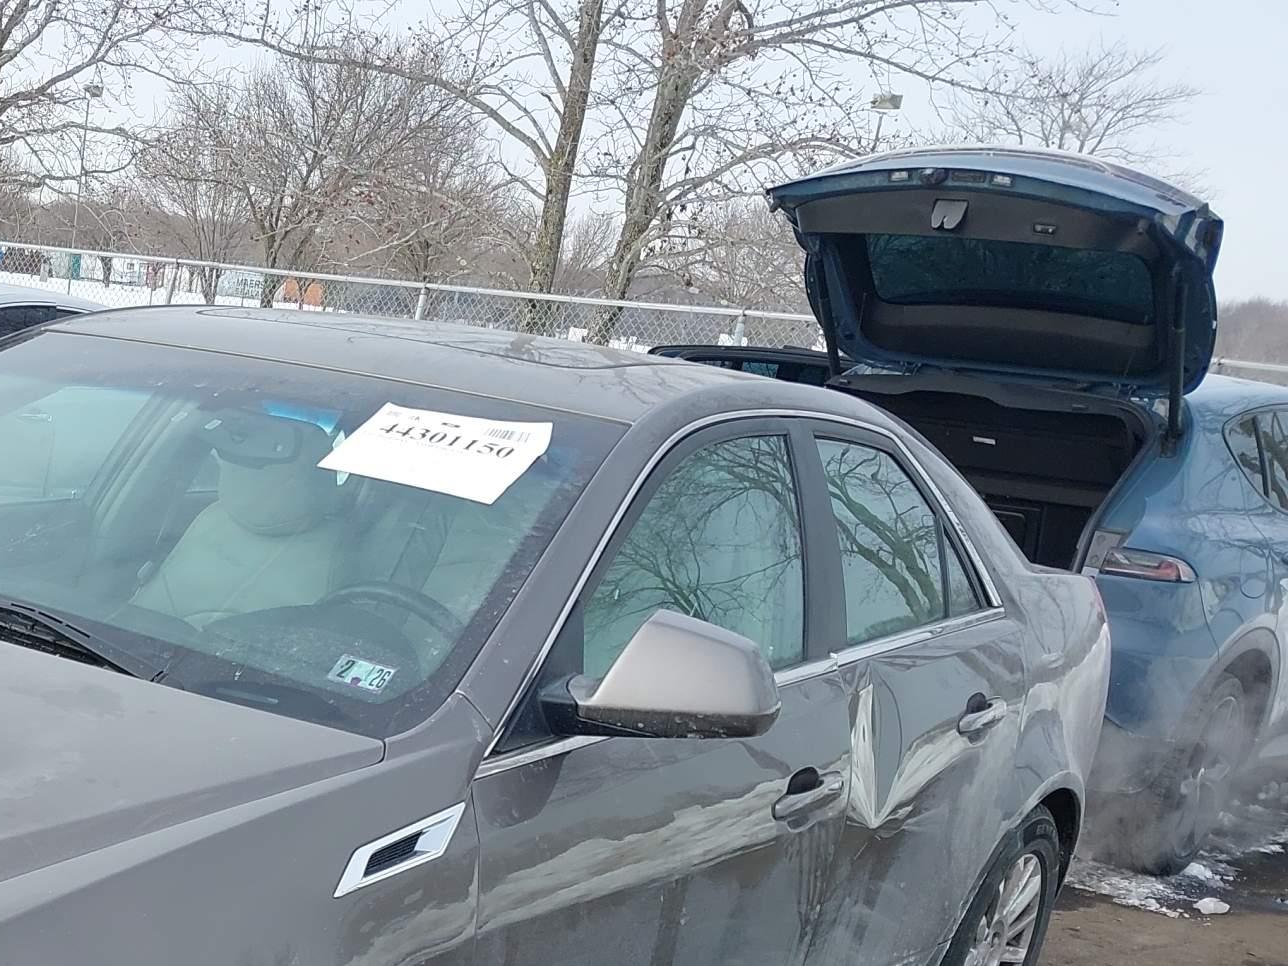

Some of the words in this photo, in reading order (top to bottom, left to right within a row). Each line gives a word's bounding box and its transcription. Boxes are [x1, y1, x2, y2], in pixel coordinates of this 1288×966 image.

[235, 278, 264, 290] MAERS
[380, 423, 515, 459] 44301150
[336, 659, 356, 679] 2
[368, 668, 392, 689] 26
